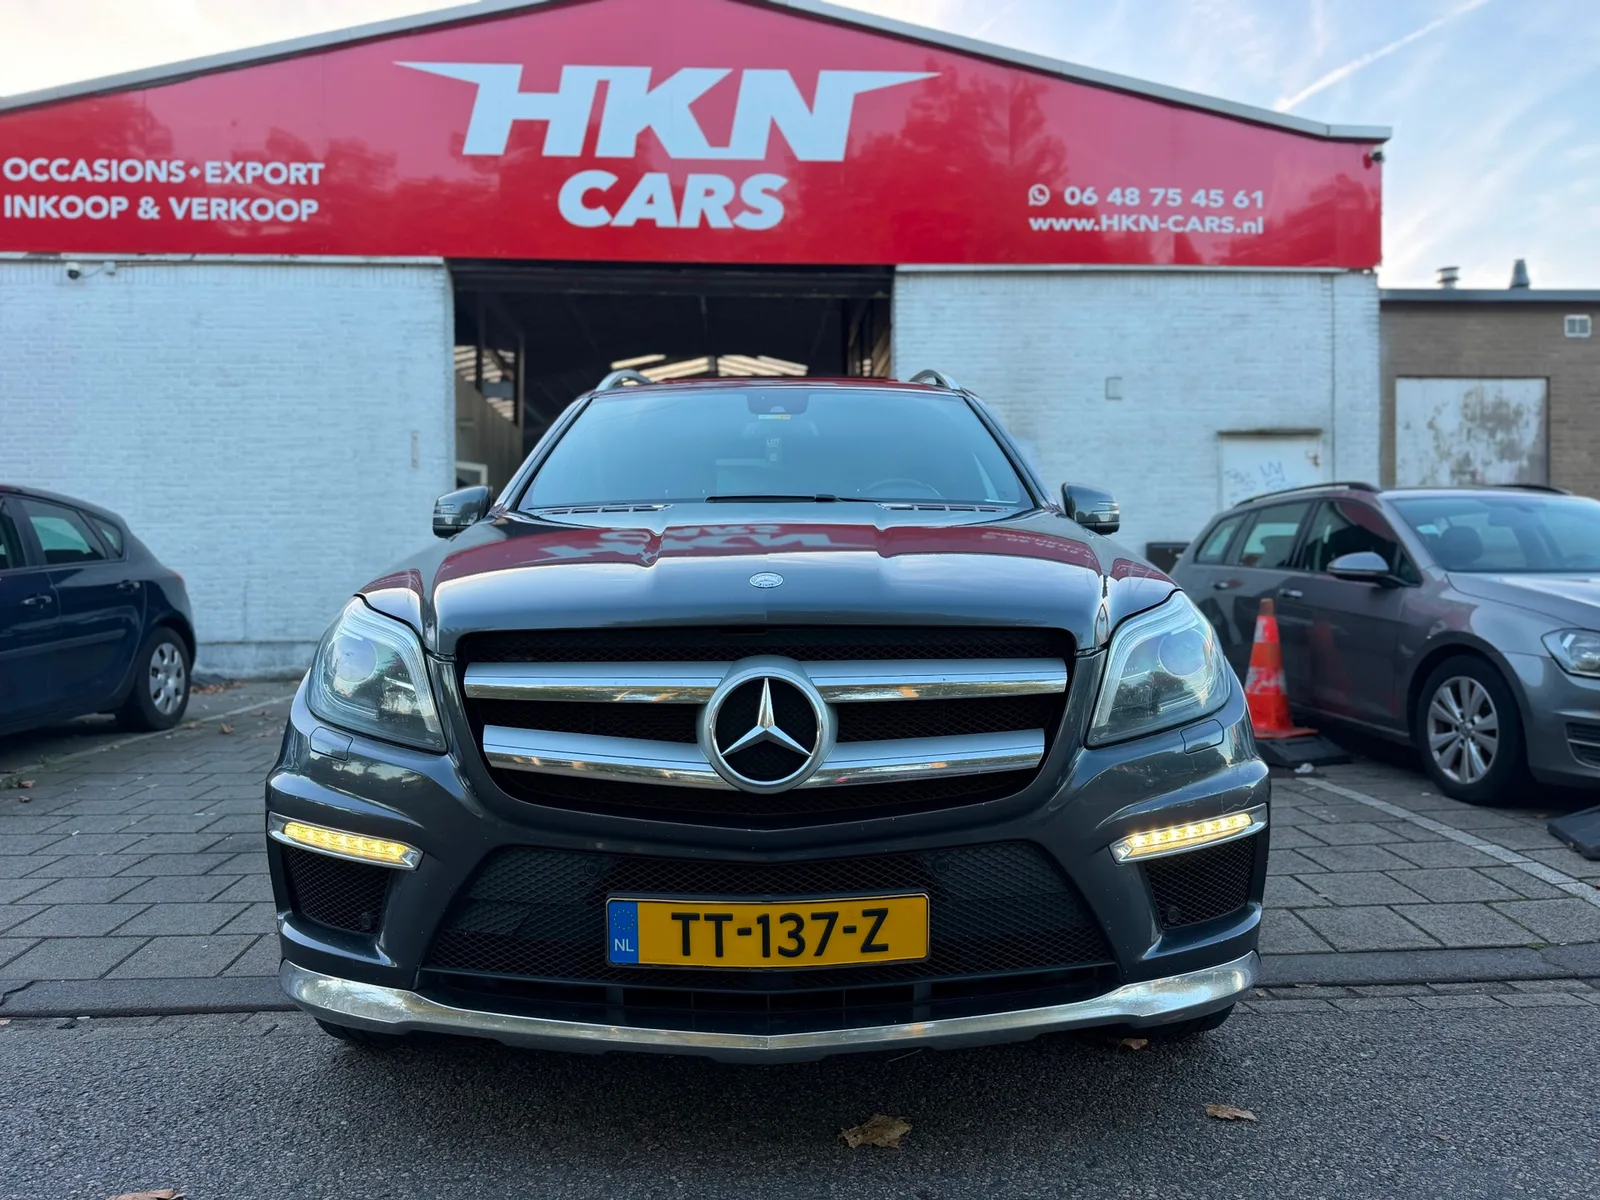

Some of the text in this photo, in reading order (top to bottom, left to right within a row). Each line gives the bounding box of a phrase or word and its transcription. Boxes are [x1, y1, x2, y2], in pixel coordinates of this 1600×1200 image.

[392, 61, 943, 163] HKN
[3, 157, 325, 186] OCCASIONS EXPORT
[3, 195, 320, 222] INKOOP & VERKOOP
[558, 169, 789, 231] CARS
[1063, 186, 1264, 209] 06 48 75 45 61
[1028, 213, 1265, 235] www.HKN-CARS.nl
[614, 938, 635, 952] NL
[671, 908, 889, 957] TT-137-Z
